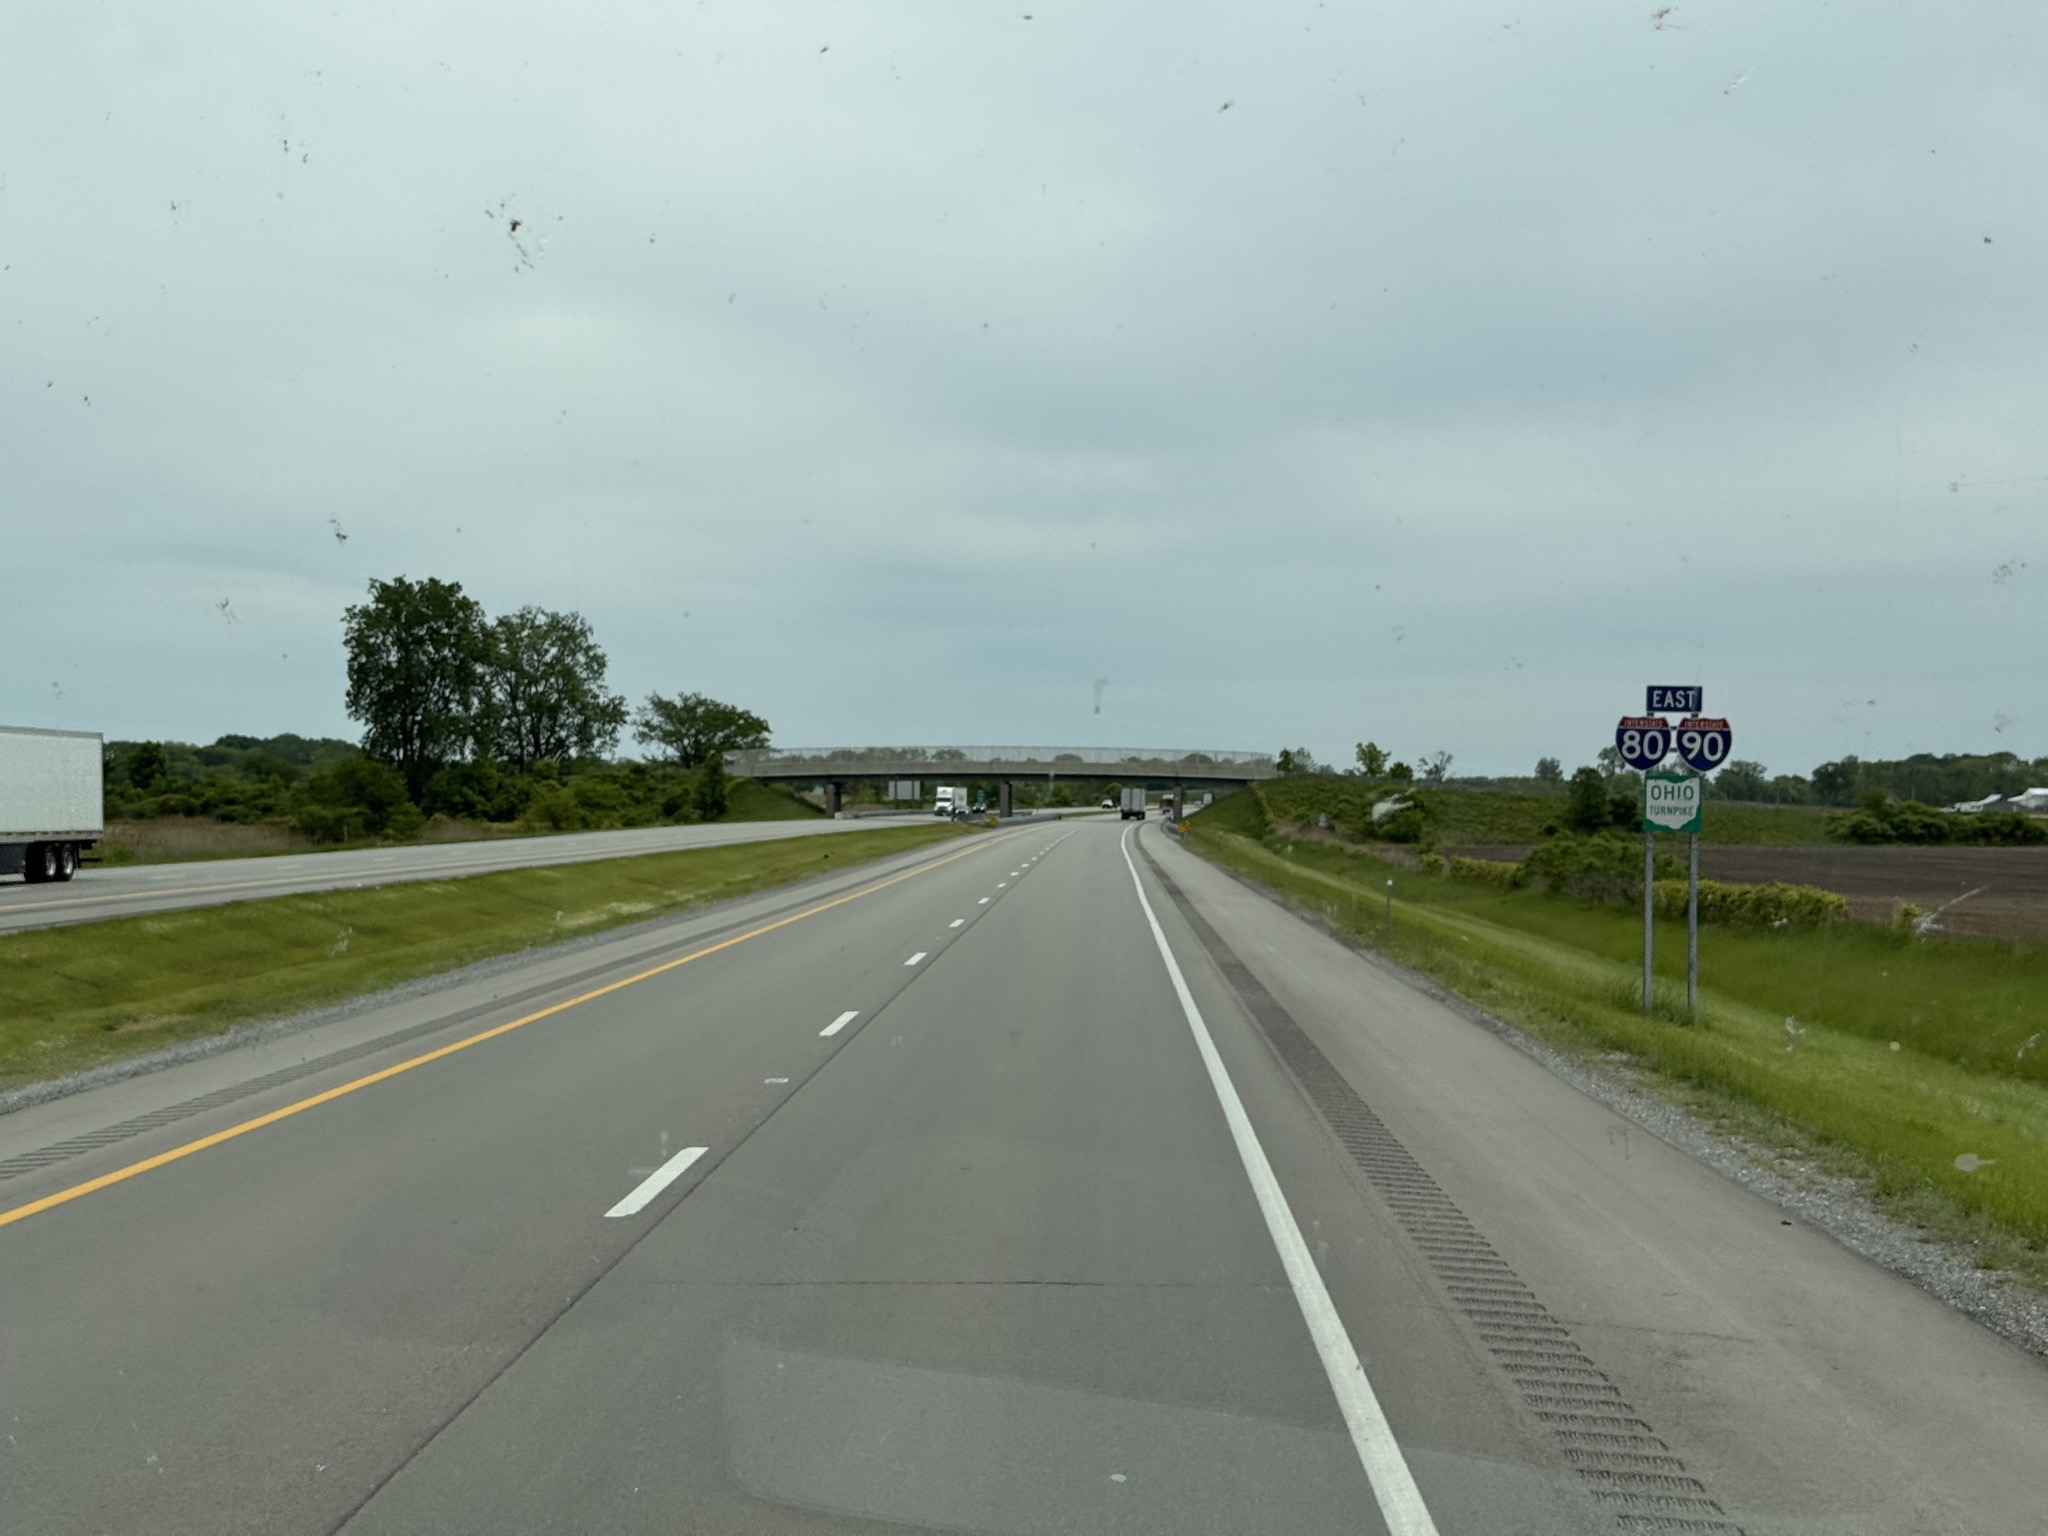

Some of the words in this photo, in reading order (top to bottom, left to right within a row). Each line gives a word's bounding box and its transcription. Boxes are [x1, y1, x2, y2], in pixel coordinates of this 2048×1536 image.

[1653, 690, 1696, 708] EAST
[1624, 720, 1663, 728] INTERSTATE
[1622, 730, 1663, 760] 80
[1682, 731, 1724, 762] 90
[1651, 785, 1694, 800] OHIO
[1649, 805, 1694, 816] TURNPIKE
